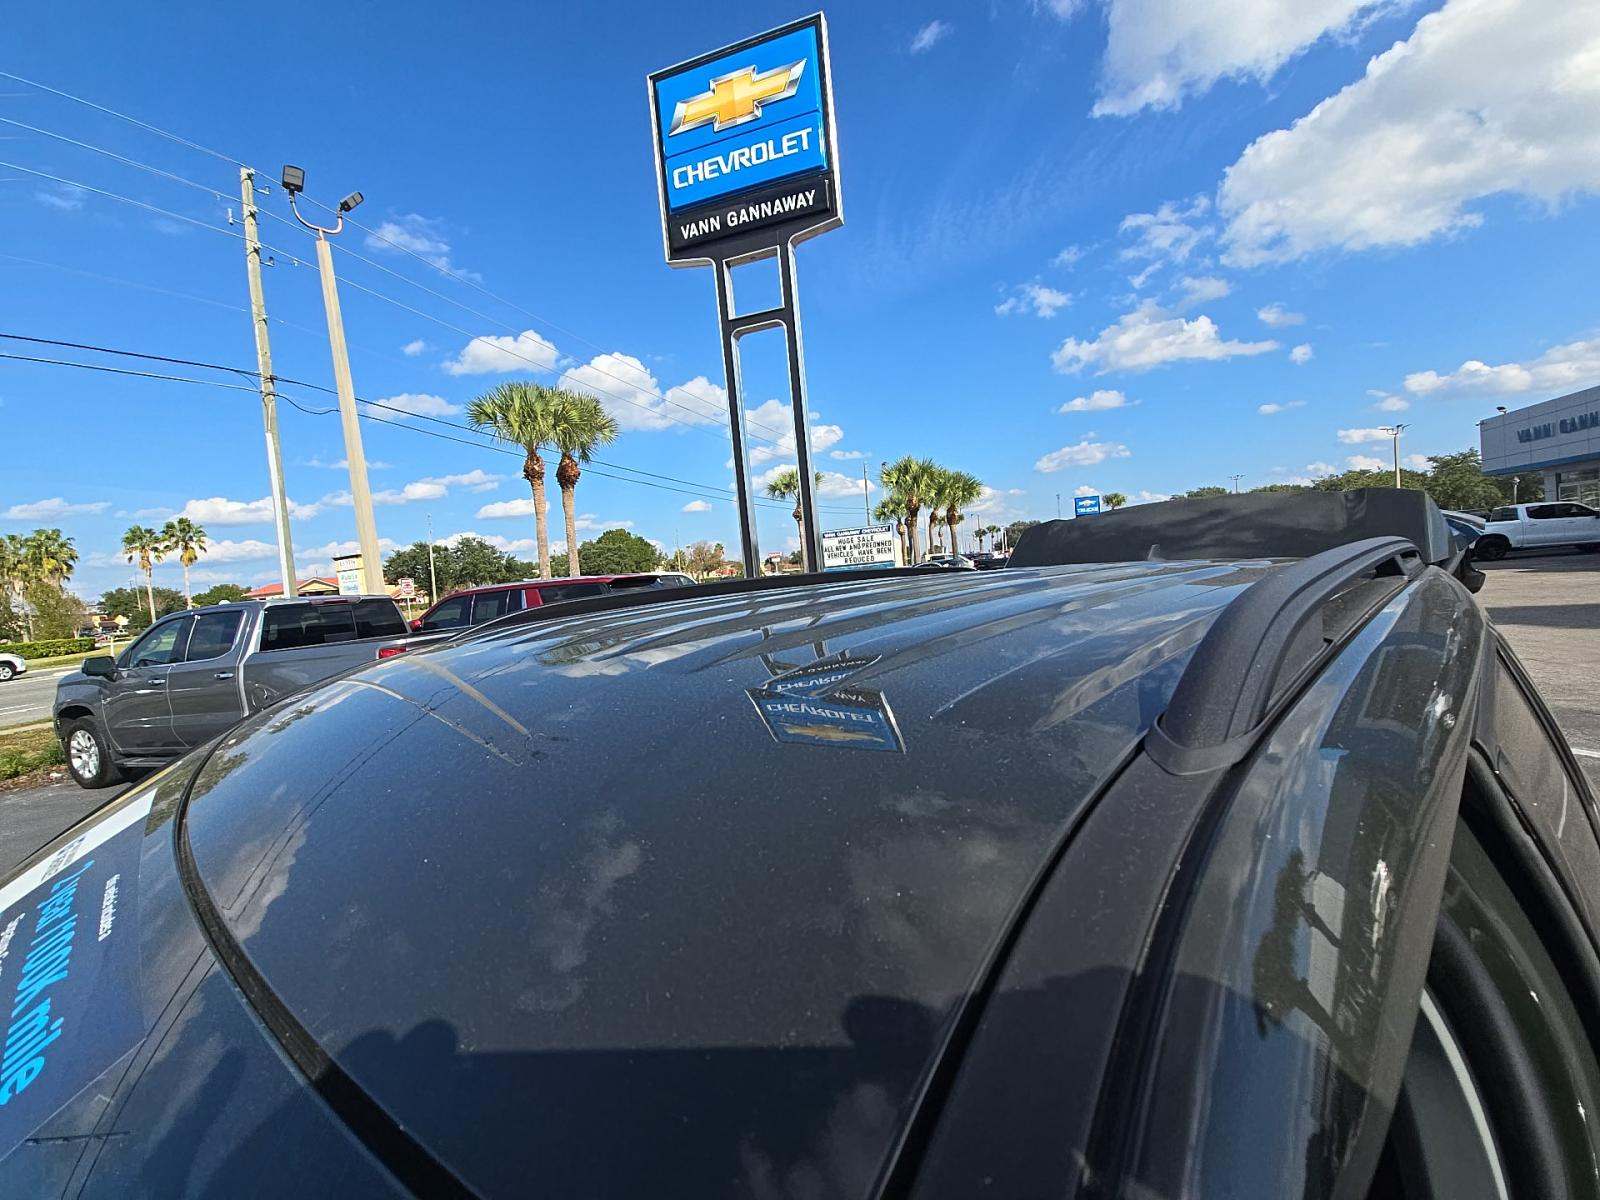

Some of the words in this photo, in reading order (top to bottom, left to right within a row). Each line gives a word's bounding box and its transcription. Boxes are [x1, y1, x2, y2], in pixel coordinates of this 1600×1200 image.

[672, 127, 813, 189] CHEVROLET
[680, 214, 722, 241] VANN
[727, 190, 816, 227] GANNAWAY
[837, 537, 854, 545] HUGE
